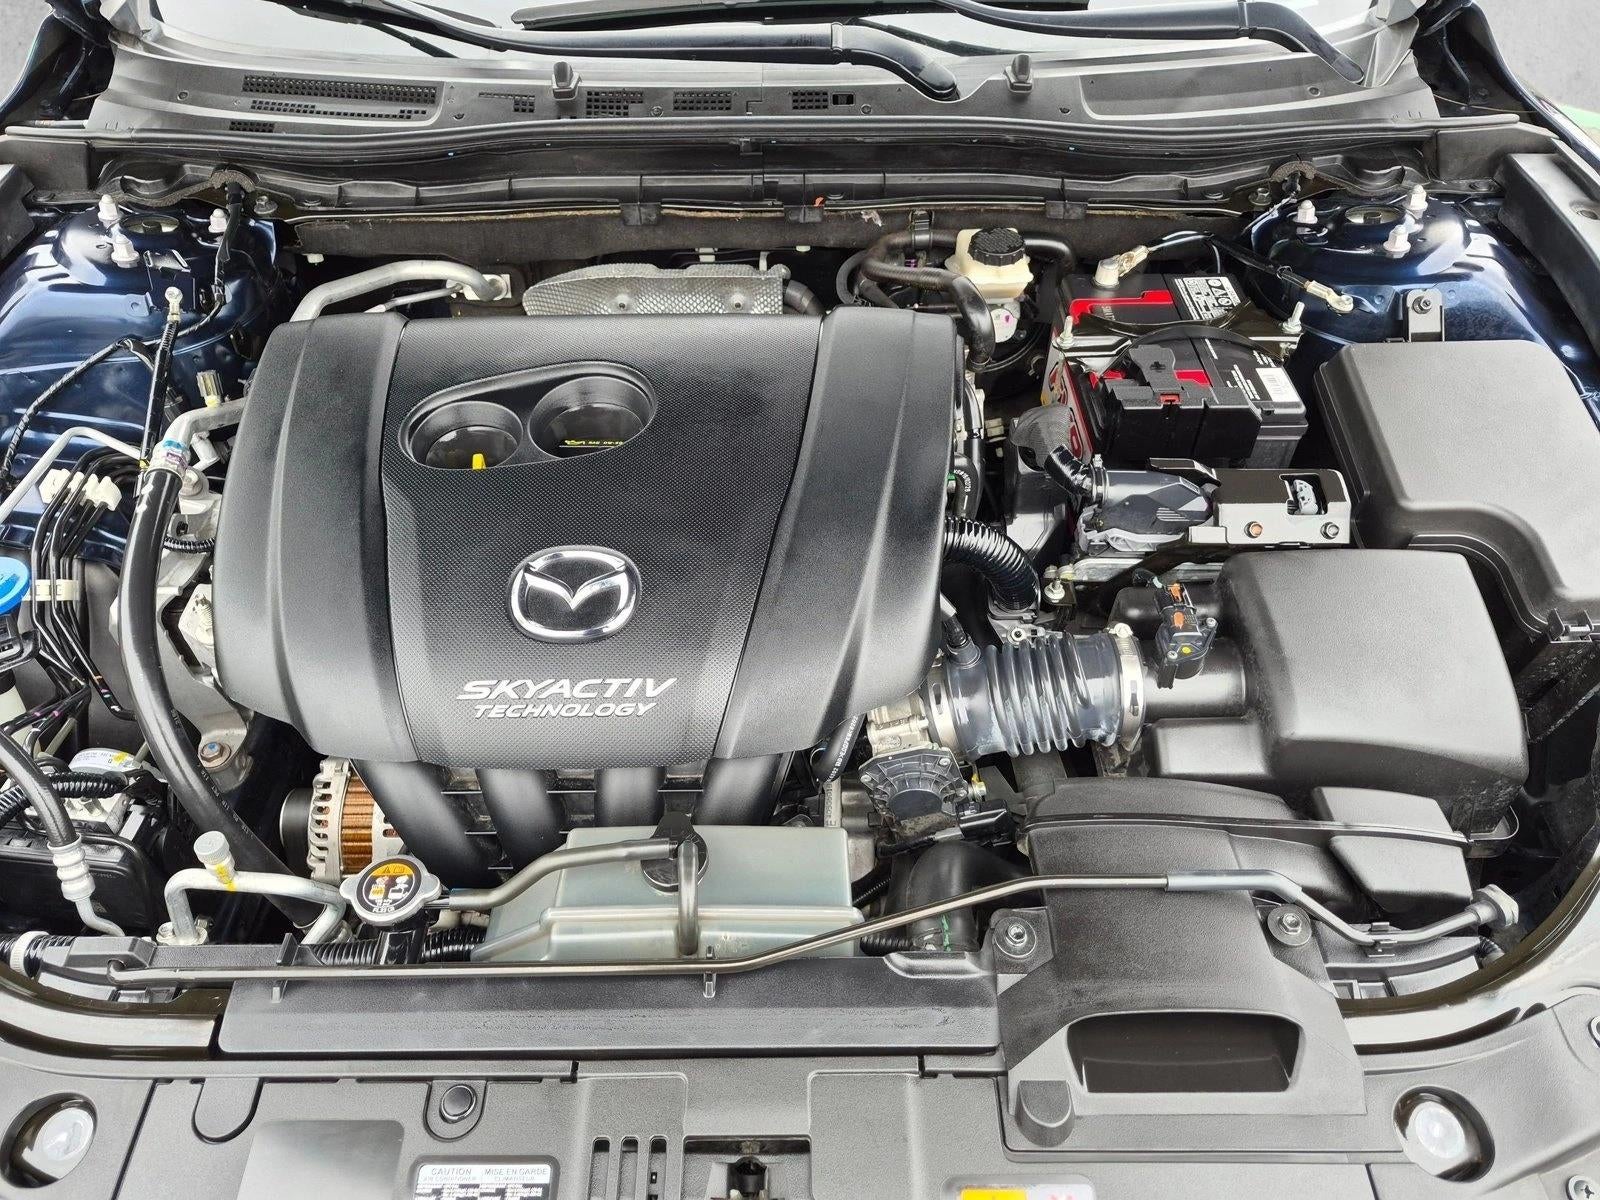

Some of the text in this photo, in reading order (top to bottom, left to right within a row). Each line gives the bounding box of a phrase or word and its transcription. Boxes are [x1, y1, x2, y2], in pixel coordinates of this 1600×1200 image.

[456, 678, 677, 700] SKYACTIV
[474, 702, 657, 719] TECHNOLOGY
[432, 1168, 472, 1176] CAUTION
[484, 1168, 548, 1176] MISE EN GARDE
